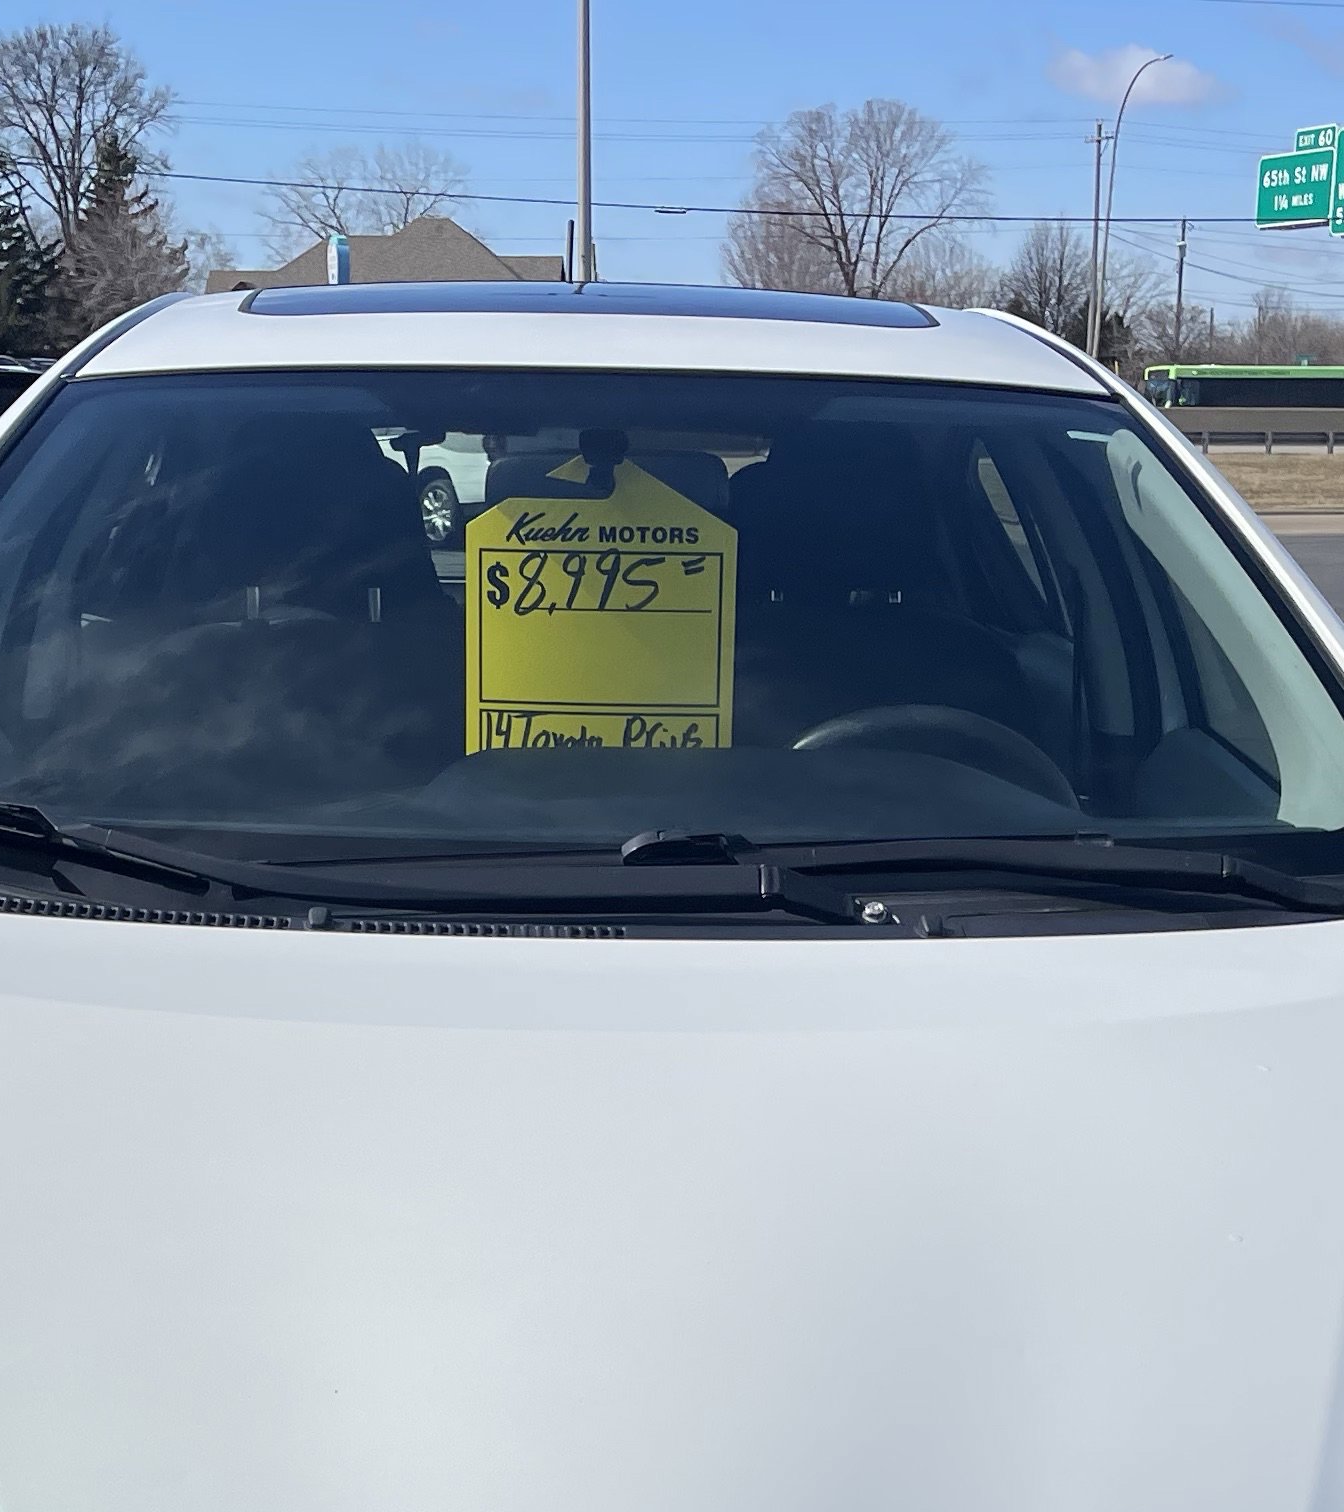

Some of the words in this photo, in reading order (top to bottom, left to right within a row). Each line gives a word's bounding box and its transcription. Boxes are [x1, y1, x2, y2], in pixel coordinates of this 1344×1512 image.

[1298, 133, 1316, 147] EXIT
[1318, 128, 1333, 147] 60
[1262, 169, 1290, 188] 65th
[1294, 166, 1307, 184] St
[1311, 163, 1329, 182] NW
[1291, 192, 1314, 207] MILES
[506, 511, 590, 545] Kuehn
[598, 525, 699, 544] MOTORS
